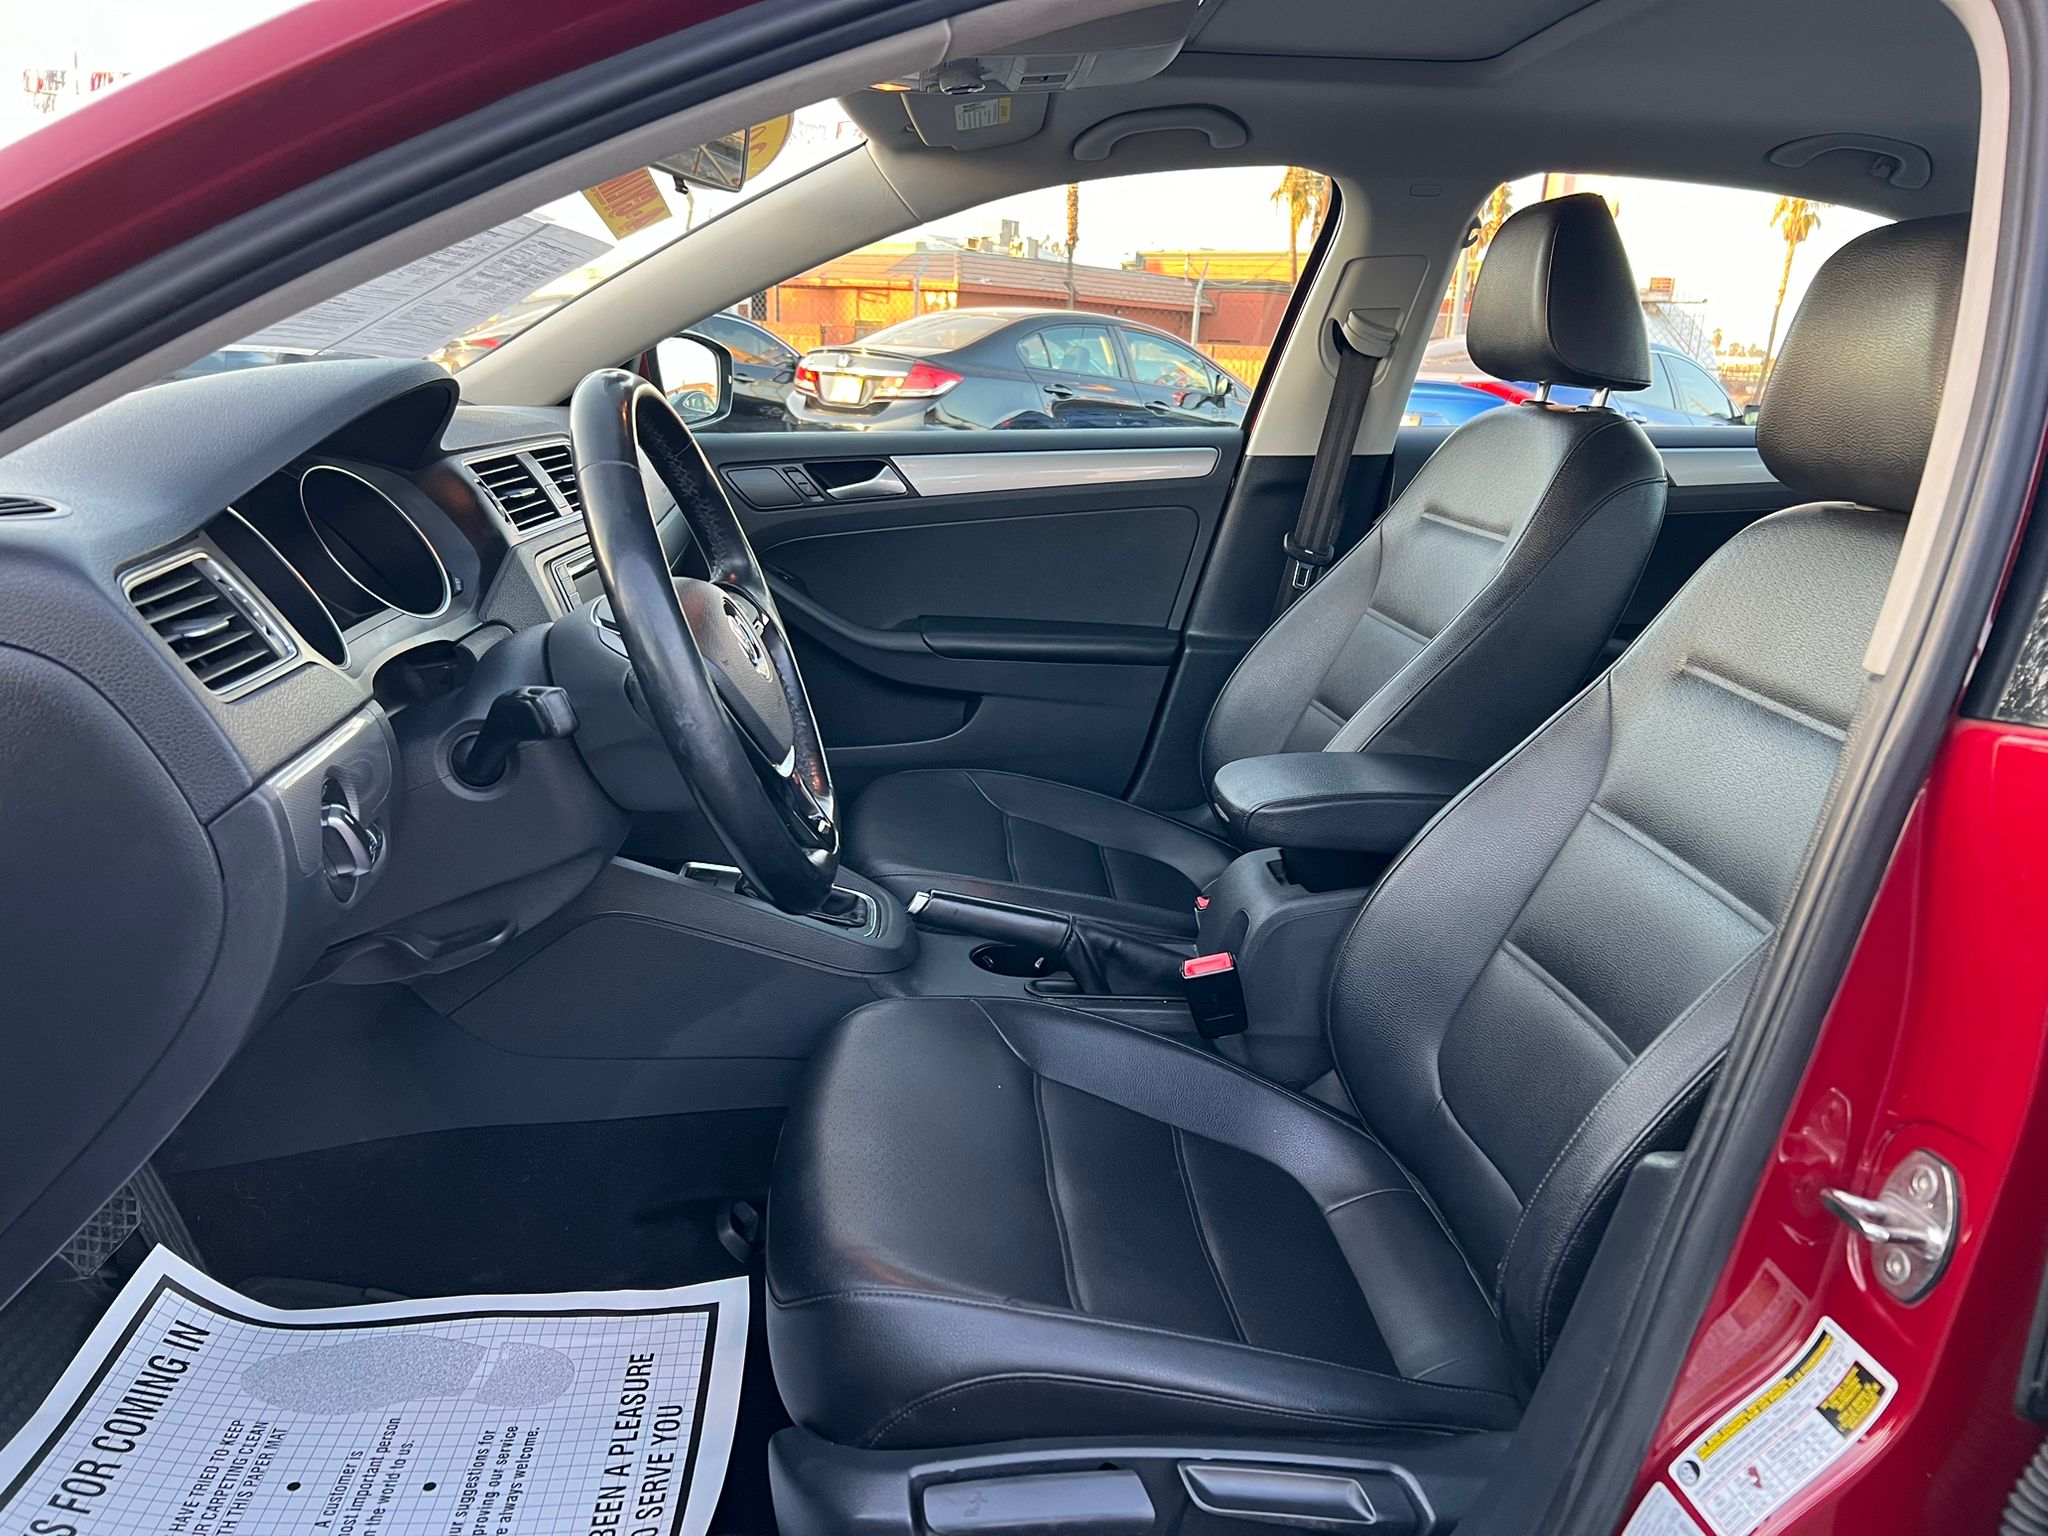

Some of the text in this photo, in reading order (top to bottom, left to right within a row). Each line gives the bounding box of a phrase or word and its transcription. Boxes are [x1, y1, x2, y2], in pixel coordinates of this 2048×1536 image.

[47, 1459, 122, 1514] FOR
[91, 1355, 191, 1453] COMING
[162, 1320, 211, 1352] IN
[496, 1426, 518, 1465] service
[588, 1353, 654, 1536] BEEN A PLEASURE
[651, 1405, 683, 1446] YOU
[168, 1420, 245, 1532] HAVE TRIED TO KEEP
[201, 1458, 248, 1520] CARPETING
[238, 1421, 269, 1454] CLEAN
[216, 1427, 288, 1535] TH THIS PAPER MAT
[314, 1451, 364, 1528] A customer is
[338, 1418, 401, 1536] ost important person
[365, 1508, 385, 1525] the
[377, 1473, 400, 1504] world
[389, 1458, 406, 1469] to
[398, 1440, 415, 1455] us.
[448, 1431, 496, 1536] ur suggestions for
[489, 1469, 504, 1488] our
[499, 1482, 523, 1523] always
[514, 1427, 540, 1480] welcome.
[635, 1453, 674, 1520] SERVE
